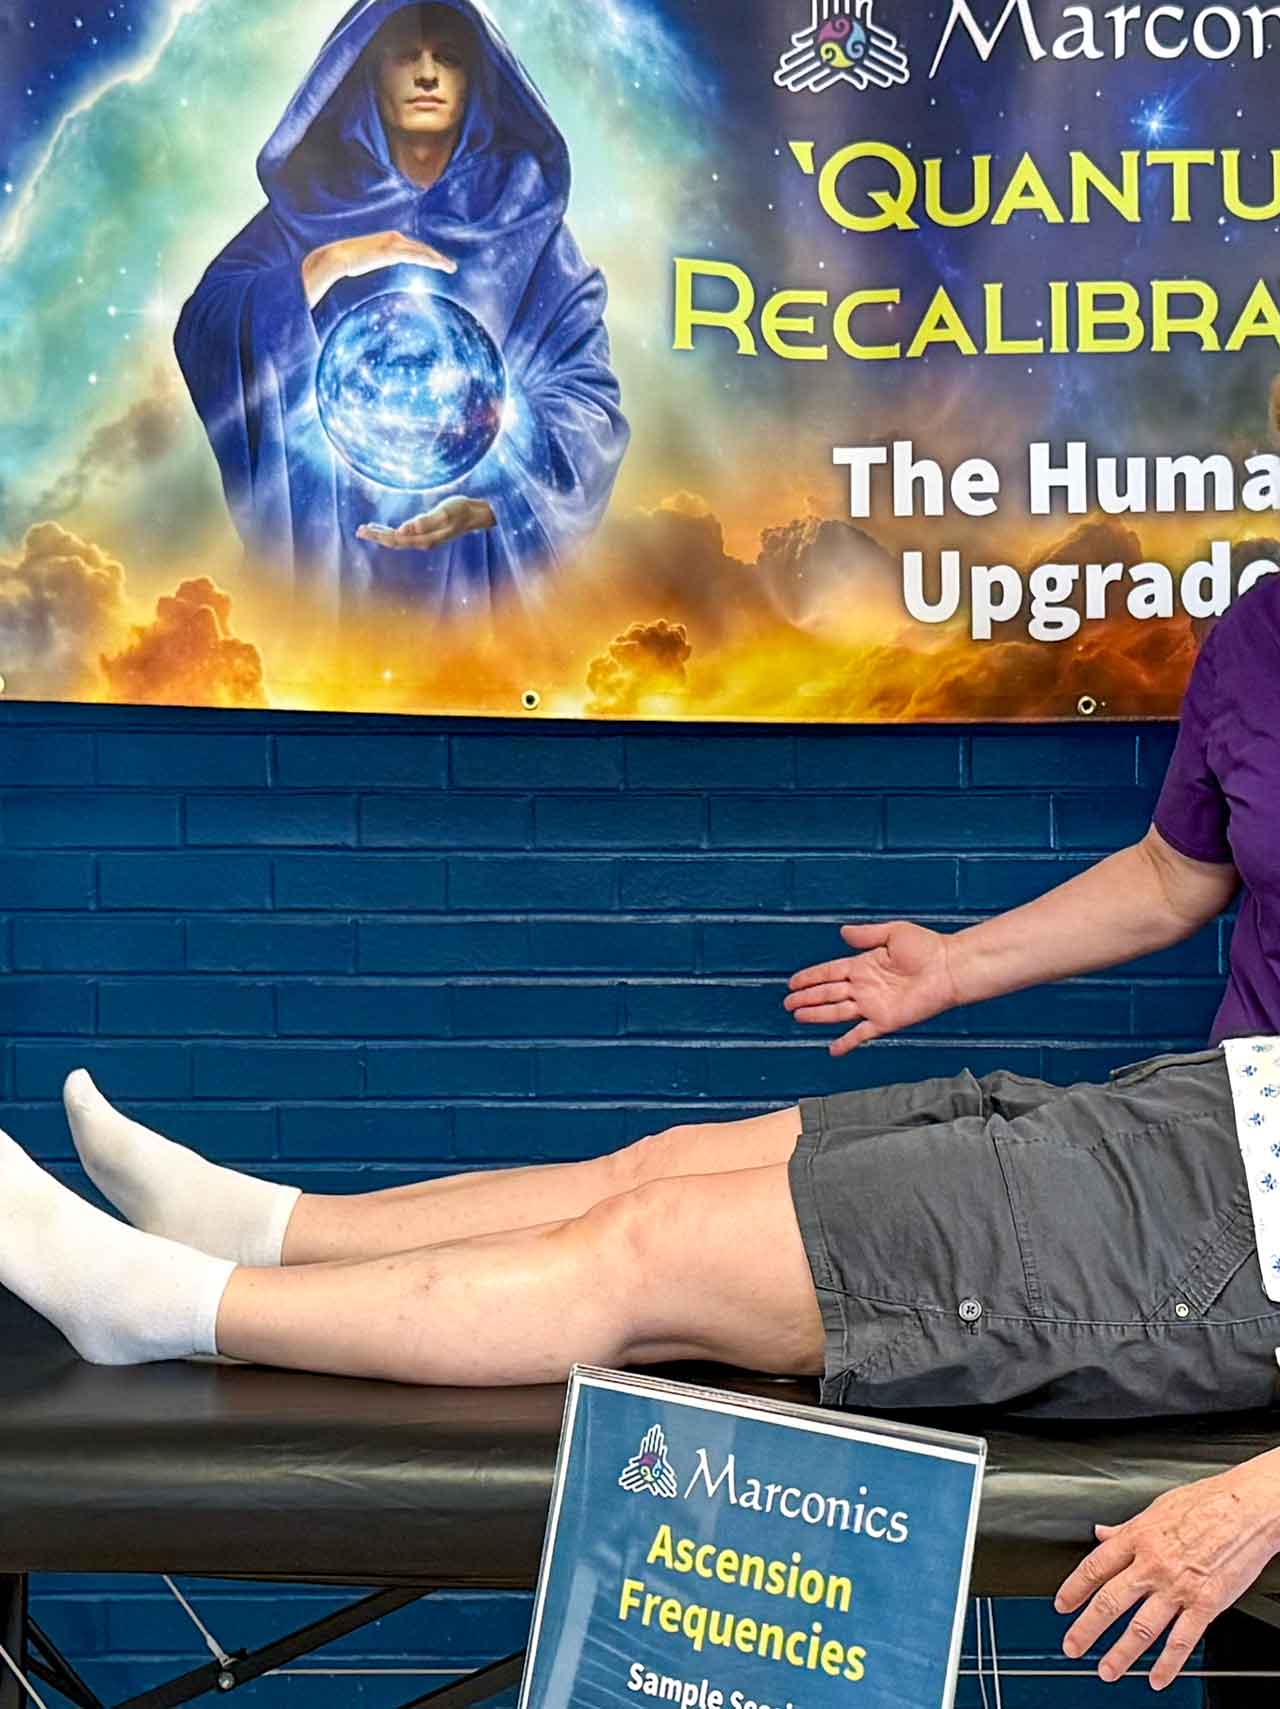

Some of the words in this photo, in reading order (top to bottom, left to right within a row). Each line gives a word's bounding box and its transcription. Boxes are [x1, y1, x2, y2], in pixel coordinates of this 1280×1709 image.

[832, 440, 1000, 518] The
[684, 1448, 910, 1544] Marconics
[645, 1524, 853, 1613] Ascension
[618, 1578, 868, 1682] Frequencies
[627, 1662, 724, 1709] Sample
